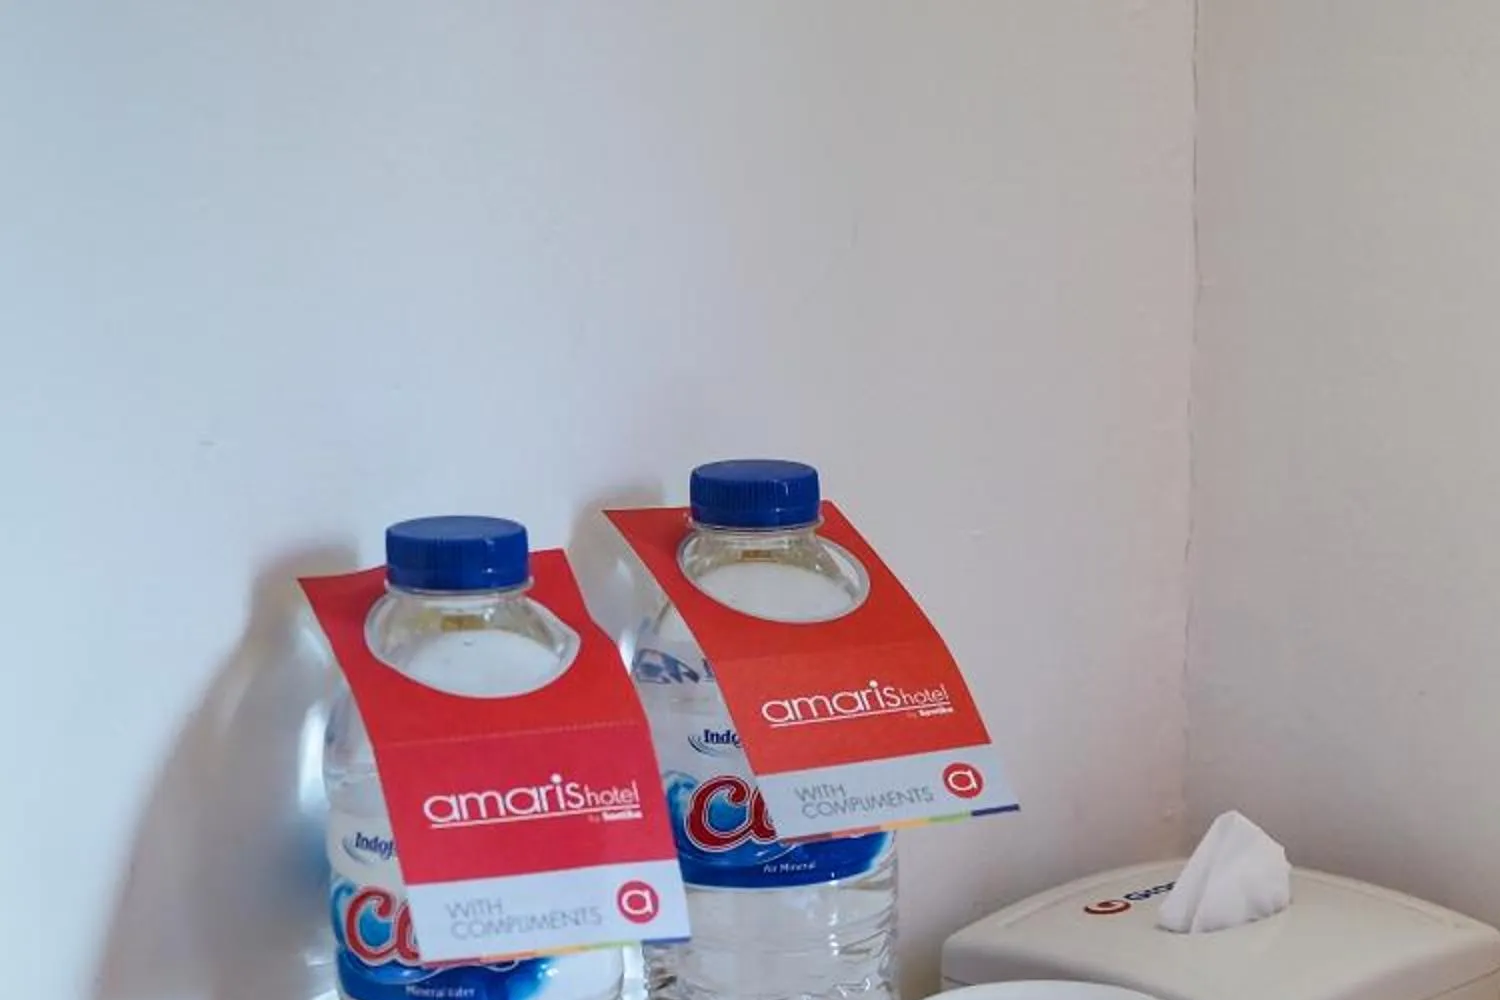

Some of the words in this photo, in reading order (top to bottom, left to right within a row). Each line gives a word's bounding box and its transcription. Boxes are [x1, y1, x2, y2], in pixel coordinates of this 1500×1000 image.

[793, 784, 847, 802] WITH
[801, 786, 935, 819] COMPLIMENTS
[444, 898, 503, 920] WITH
[450, 906, 603, 941] COMPLIMENTS
